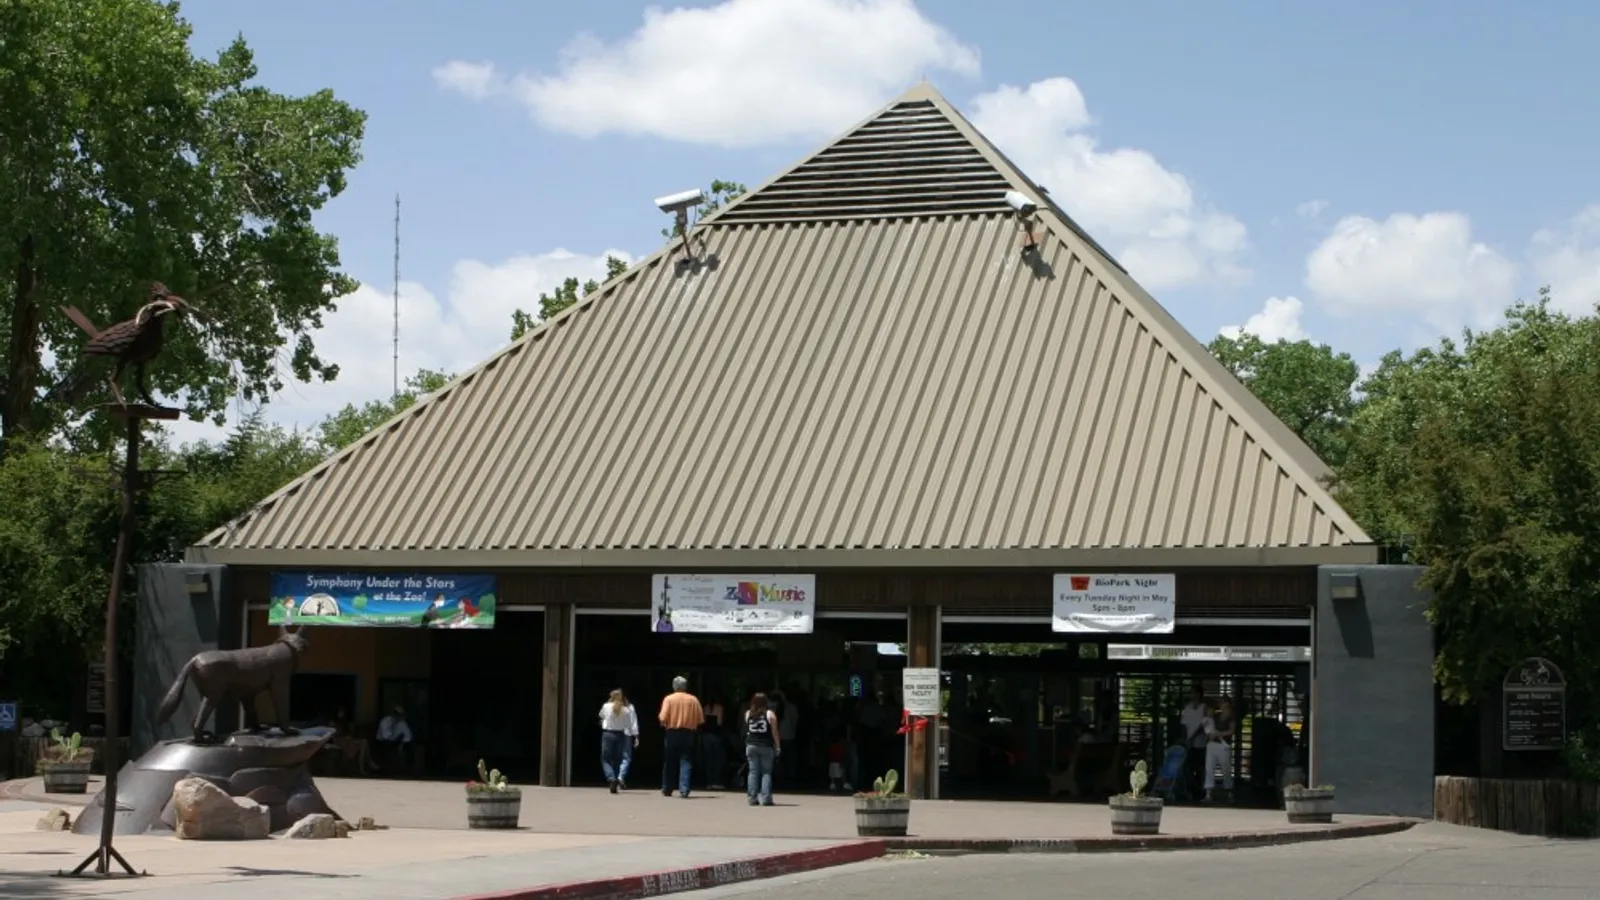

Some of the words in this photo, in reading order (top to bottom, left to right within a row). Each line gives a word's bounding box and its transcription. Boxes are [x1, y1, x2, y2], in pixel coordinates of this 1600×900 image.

[306, 575, 364, 590] Symphony
[366, 576, 401, 588] Under
[403, 577, 423, 588] the
[425, 576, 456, 589] Stars
[1094, 578, 1131, 587] BioPark
[1133, 578, 1158, 588] Night
[373, 592, 385, 601] at
[385, 591, 401, 601] the
[403, 591, 427, 602] Zoo!
[760, 582, 806, 602] Music
[1060, 593, 1082, 603] Every
[1084, 593, 1117, 603] Tuesday
[1118, 593, 1141, 604] Night
[1142, 593, 1150, 601] in
[1151, 593, 1168, 604] May
[1092, 603, 1110, 612] 5pm
[748, 719, 768, 733] 23
